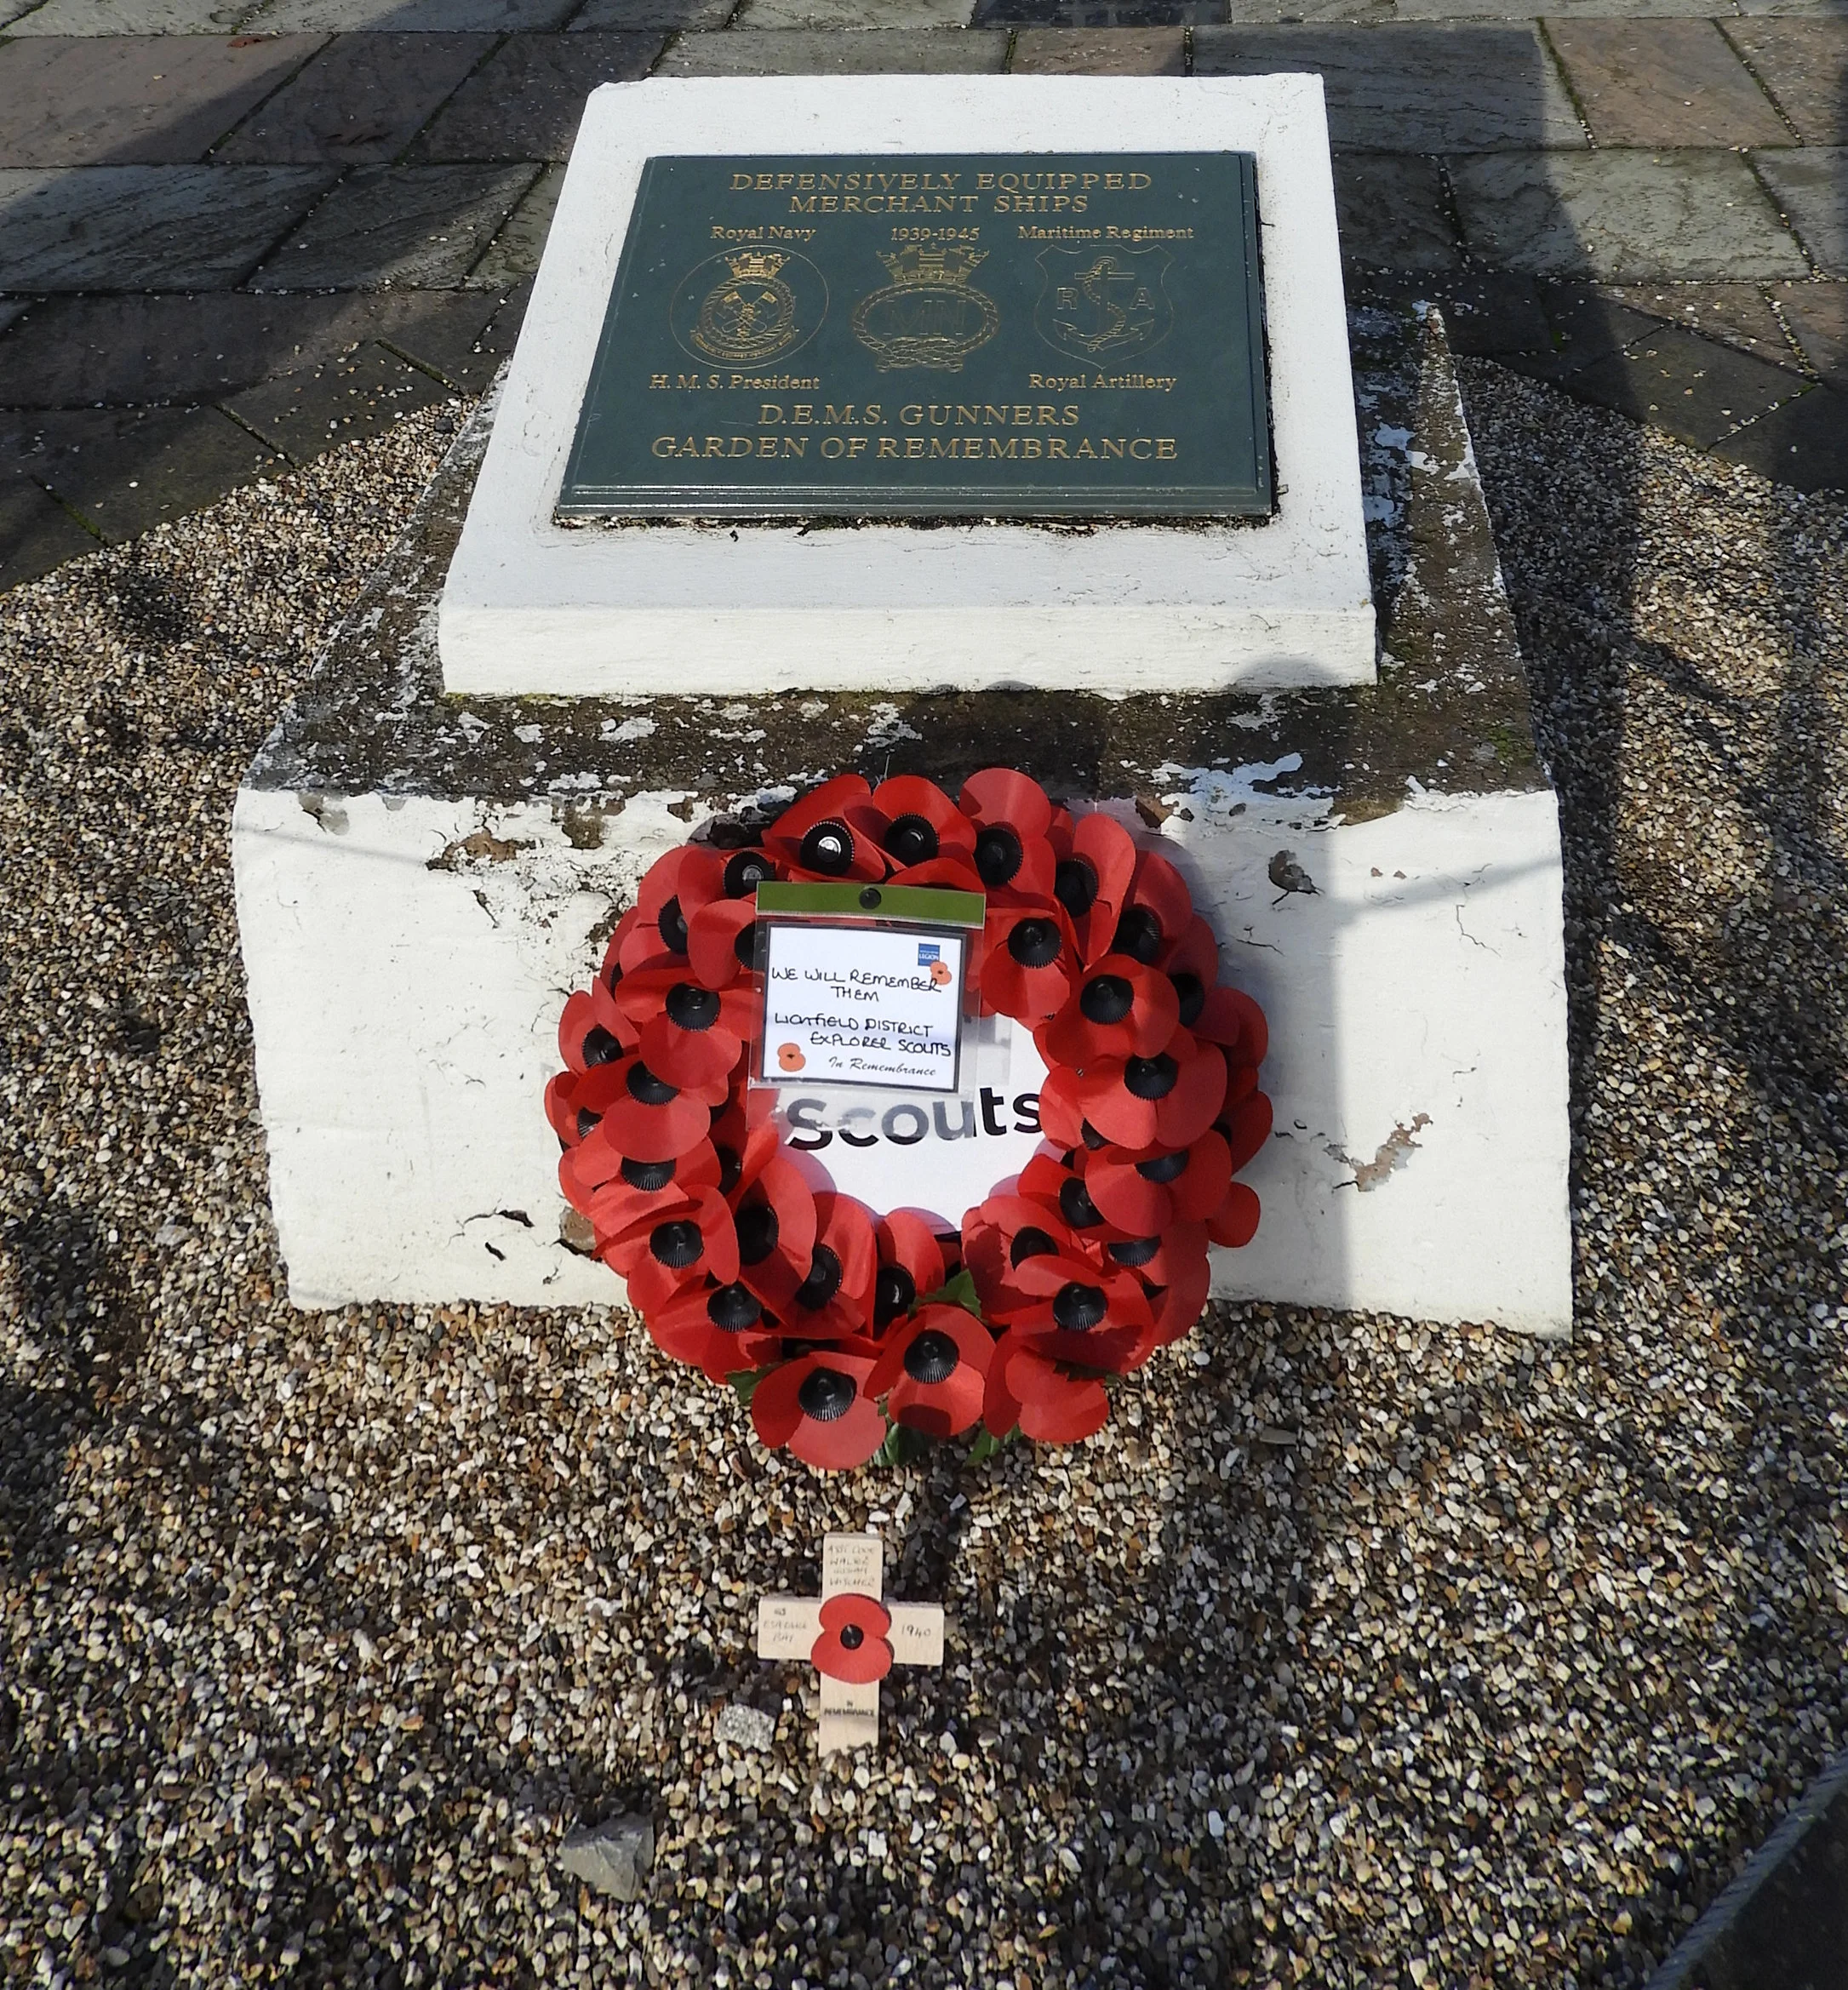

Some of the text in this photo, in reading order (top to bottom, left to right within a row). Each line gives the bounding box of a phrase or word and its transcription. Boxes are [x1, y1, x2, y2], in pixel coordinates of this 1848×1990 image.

[729, 173, 1152, 194] DEFENSIVELY EQUIPPED
[788, 195, 1089, 214] MERCHANT SHIPS
[709, 225, 816, 242] Royal Navy
[890, 226, 980, 242] 1939-1945
[1017, 225, 1195, 242] Maritime Regiment
[728, 373, 821, 391] President
[1027, 373, 1178, 392] Royal Artillery
[757, 403, 1080, 426] D.E.M.S. GUNNERS
[651, 436, 1179, 460] GARDEN OF REMEMBRANCE
[771, 967, 941, 993] WE WILL REMEMBER
[830, 986, 880, 1003] THEM
[864, 1018, 934, 1038] DISTRICT
[810, 1031, 953, 1057] EXPLORER SCOUTS
[827, 1056, 937, 1077] In Remembrance
[901, 1624, 932, 1639] 1940
